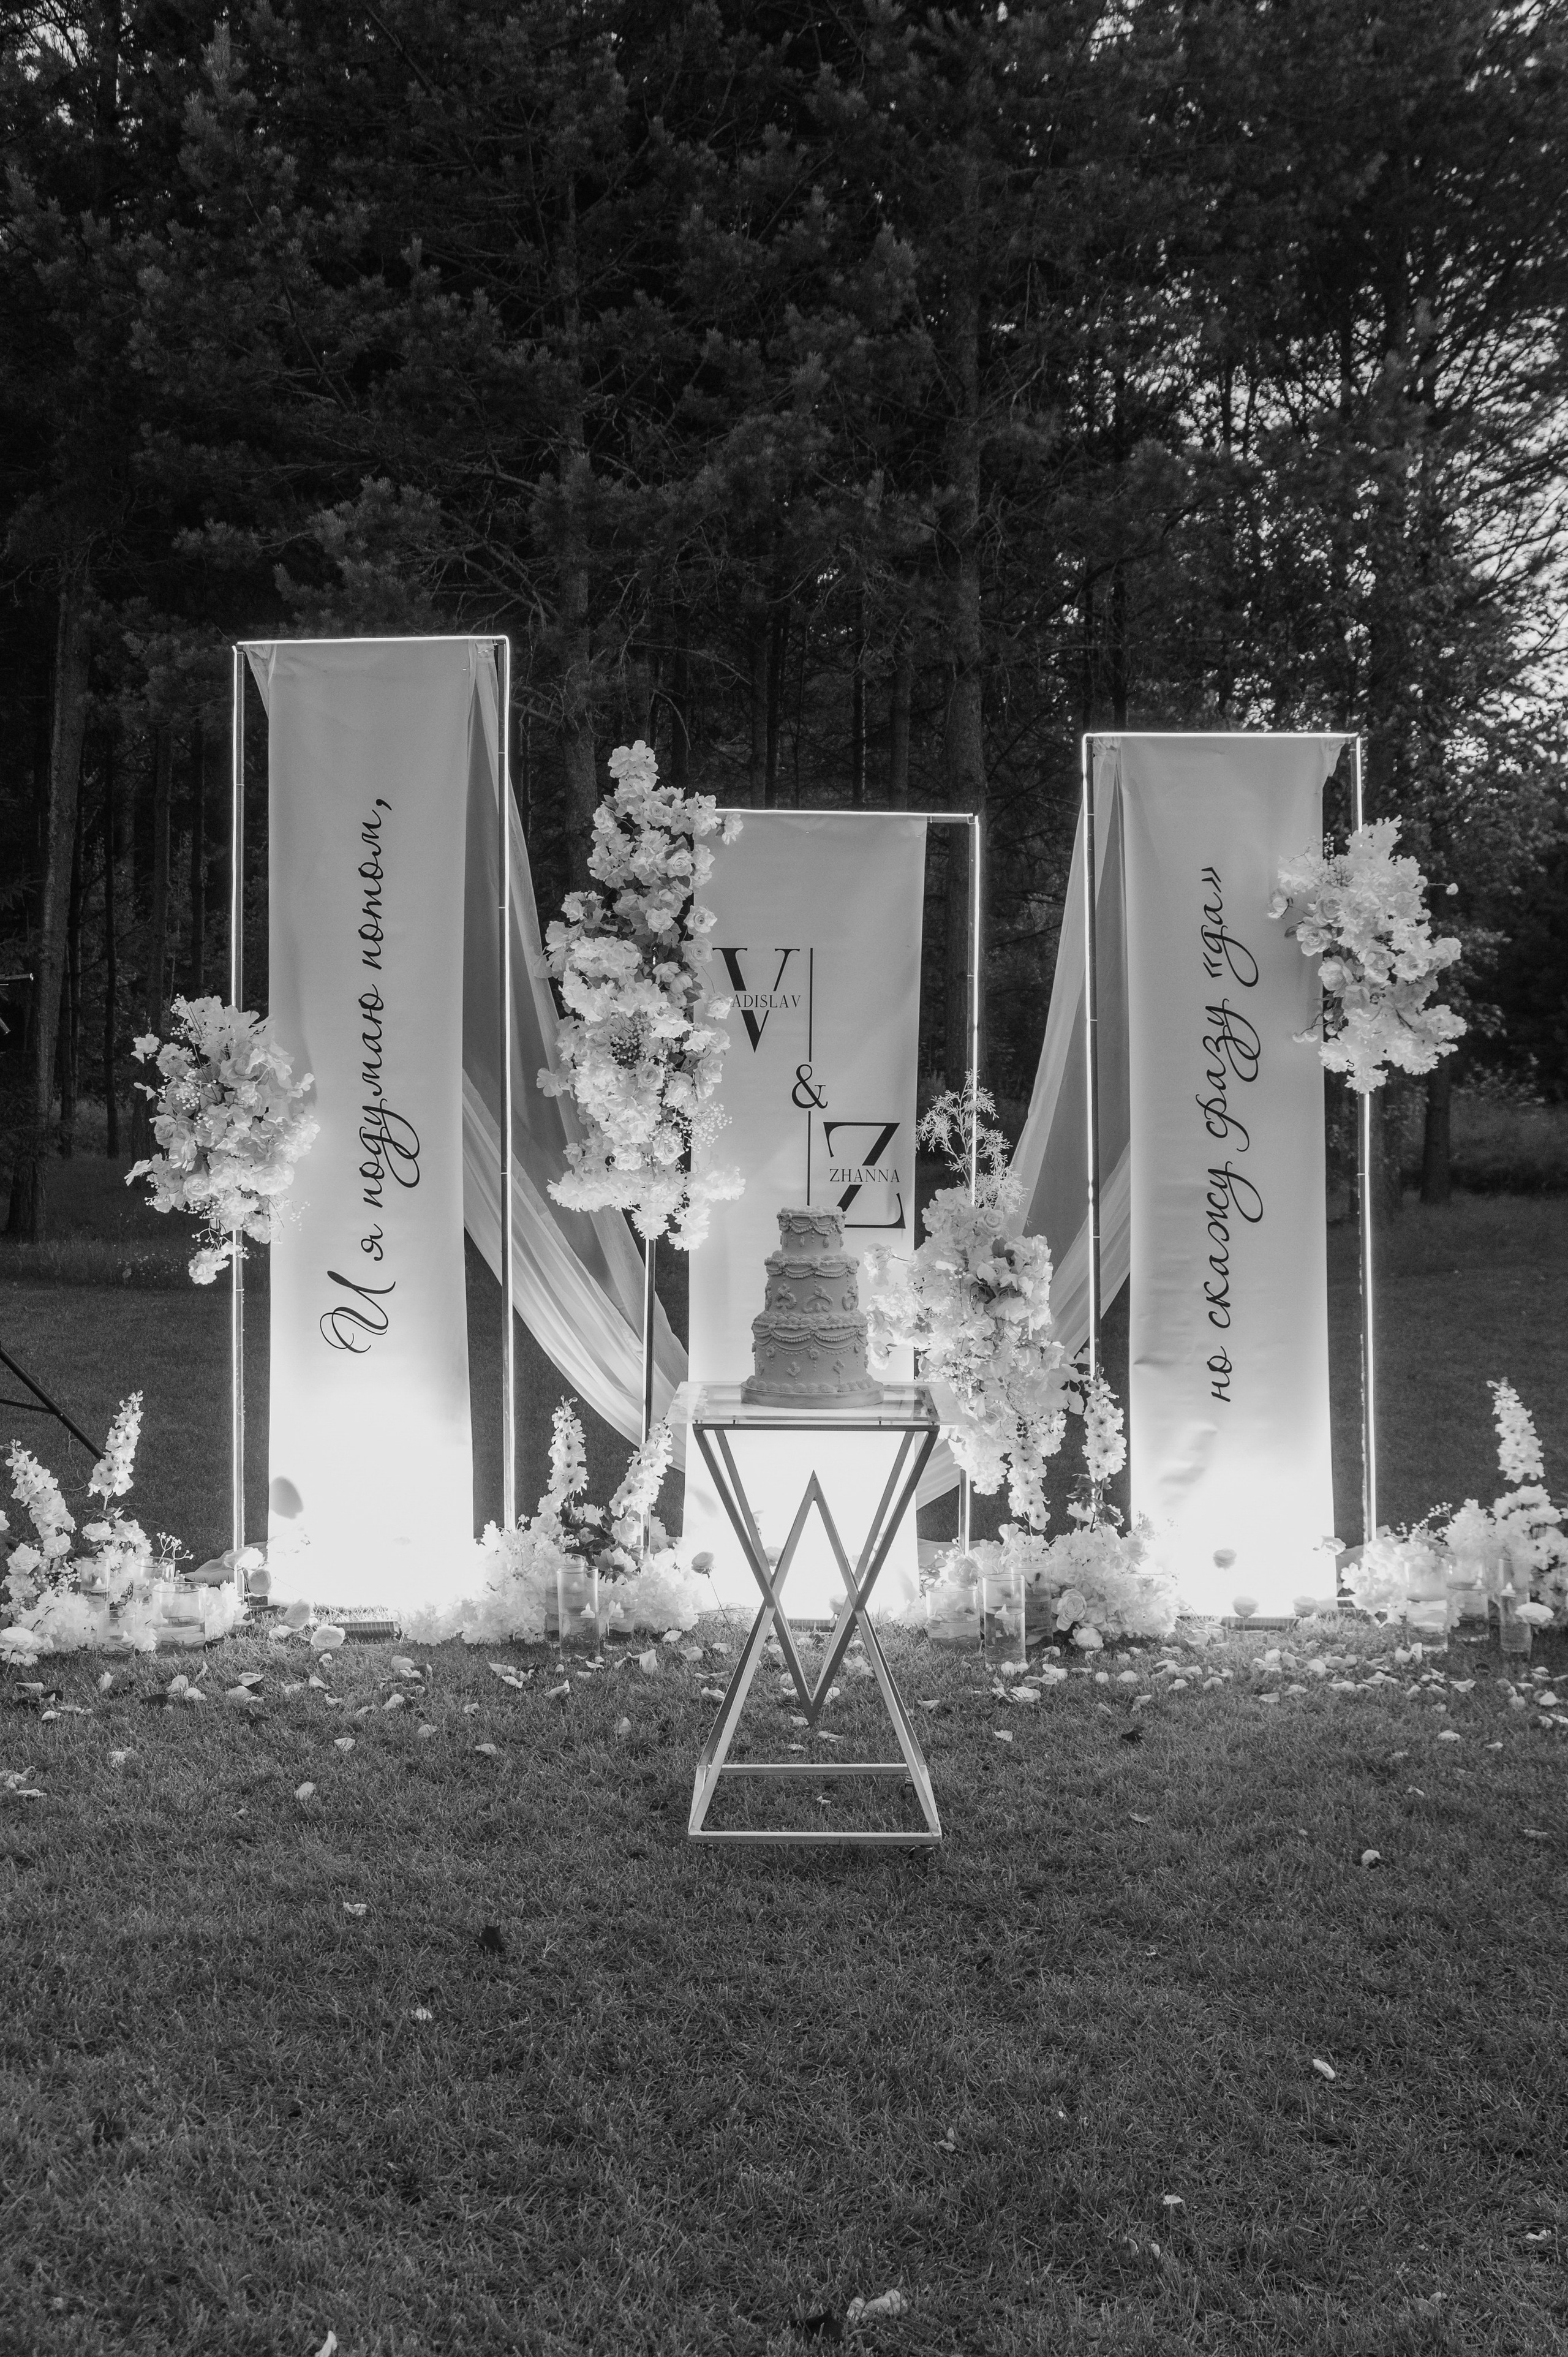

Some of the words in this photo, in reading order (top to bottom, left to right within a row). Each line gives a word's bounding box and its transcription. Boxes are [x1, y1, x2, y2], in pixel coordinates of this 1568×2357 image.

[358, 798, 393, 970] потом,
[1200, 865, 1259, 987] «да»
[712, 947, 801, 1054] V
[731, 994, 801, 1009] ADISLAV
[358, 983, 421, 1209] подумаю
[791, 1063, 829, 1110] &
[1194, 998, 1262, 1153] сразу
[823, 1121, 907, 1230] Z
[829, 1168, 901, 1183] ZHANNA
[360, 1223, 383, 1262] я
[1202, 1161, 1264, 1330] скажу
[319, 1270, 396, 1354] И
[1205, 1345, 1234, 1403] но
